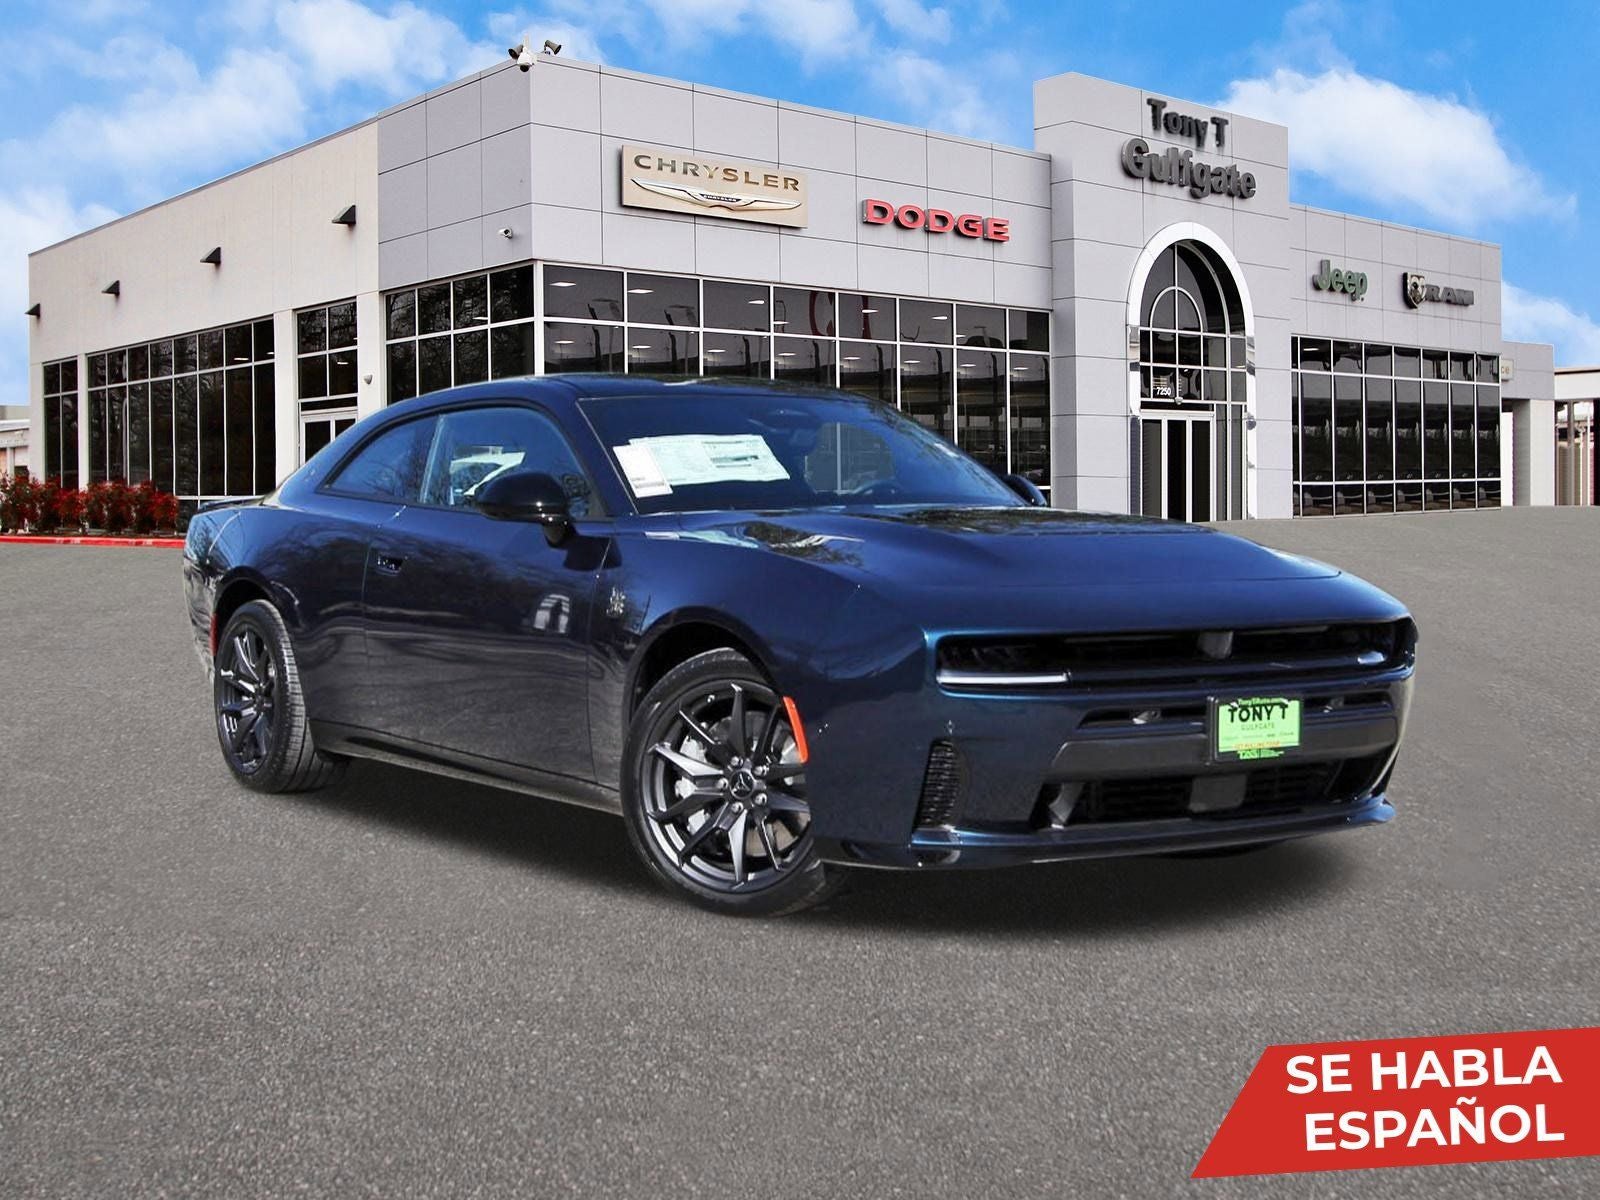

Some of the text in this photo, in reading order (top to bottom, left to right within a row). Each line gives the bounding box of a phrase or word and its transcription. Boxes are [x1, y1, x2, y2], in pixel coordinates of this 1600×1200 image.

[1146, 98, 1229, 148] Tony T
[633, 153, 800, 192] CHRYSLER
[1121, 138, 1257, 199] Gulfgate
[862, 198, 1011, 243] DODGE
[1312, 259, 1368, 302] Jeep
[1425, 284, 1475, 306] RAM
[1156, 386, 1172, 396] 7250
[1228, 703, 1289, 723] TONY T
